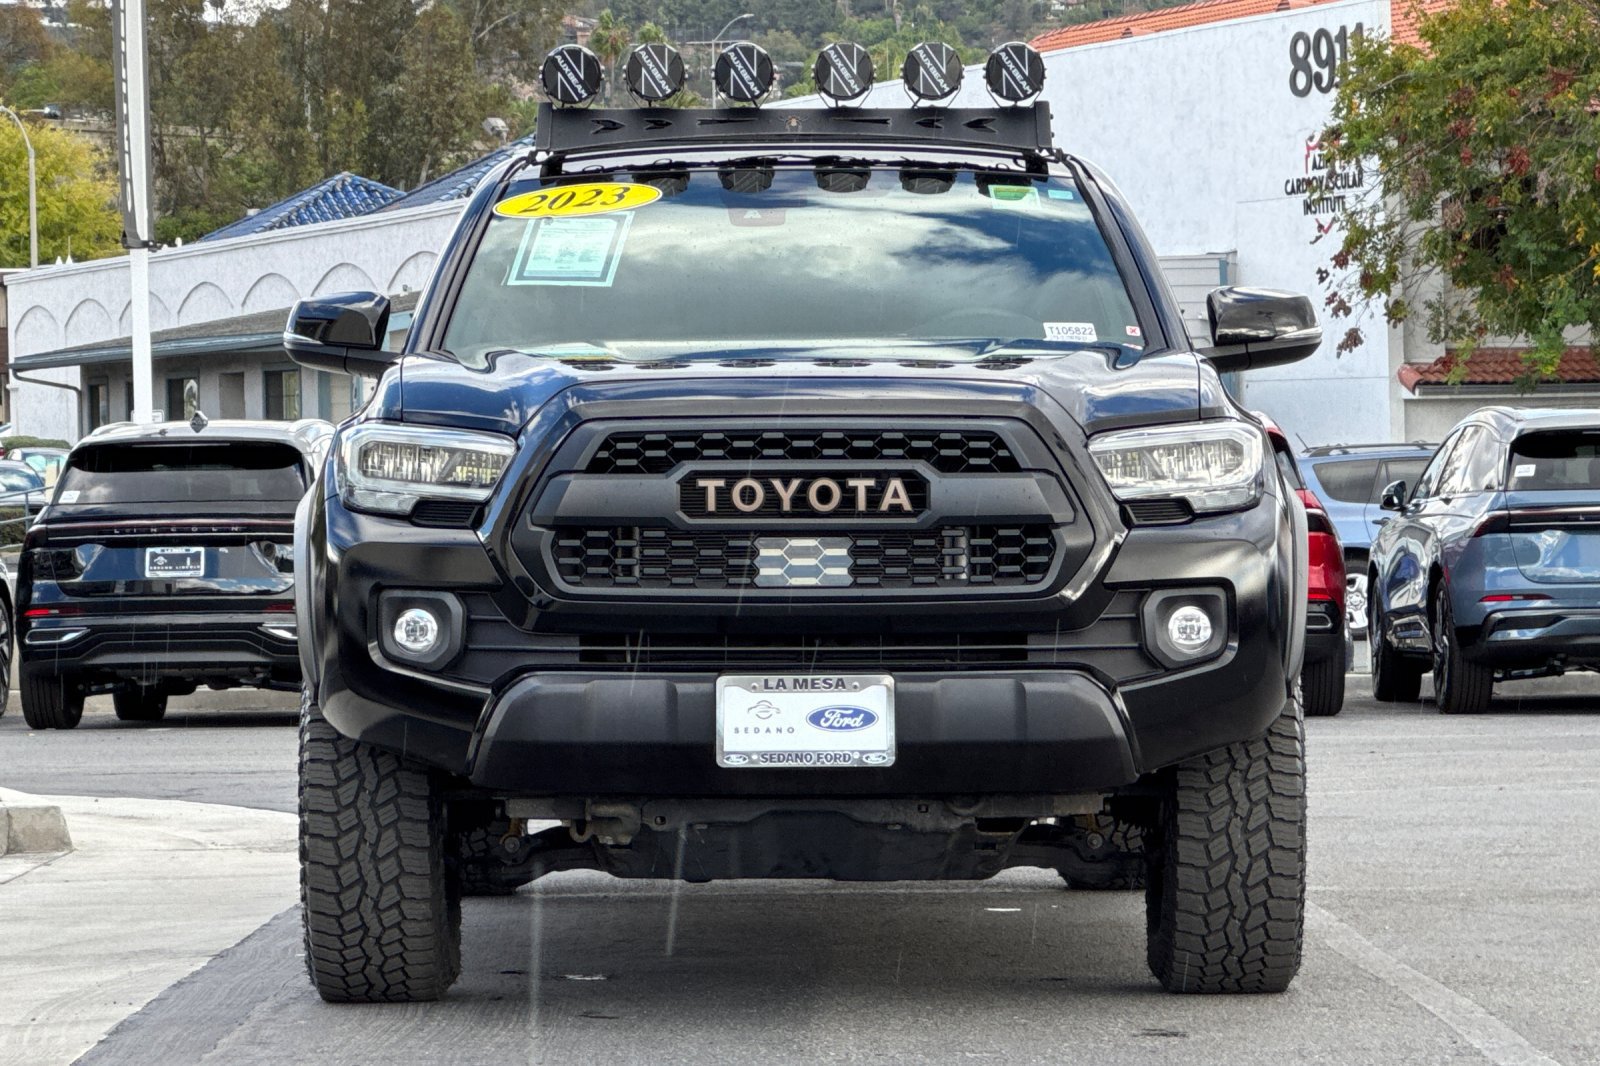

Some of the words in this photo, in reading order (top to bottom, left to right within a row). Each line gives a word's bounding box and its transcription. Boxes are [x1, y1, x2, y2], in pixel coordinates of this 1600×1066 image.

[554, 54, 587, 98] AUXBEAM
[638, 50, 671, 94] AUXBEAM
[728, 50, 760, 95] AUXBEAM
[828, 49, 859, 93] AUXBEAM
[917, 49, 949, 93] AUXBEAM
[1000, 51, 1032, 94] AUXBEAM
[1289, 22, 1363, 97] 891
[518, 186, 631, 213] 2023
[1048, 326, 1094, 335] T105822
[697, 478, 913, 512] TOYOTA
[763, 678, 787, 690] LA
[793, 677, 847, 690] MESA
[820, 709, 864, 728] Ford
[760, 753, 813, 763] SEDANO
[817, 752, 851, 763] FORD
